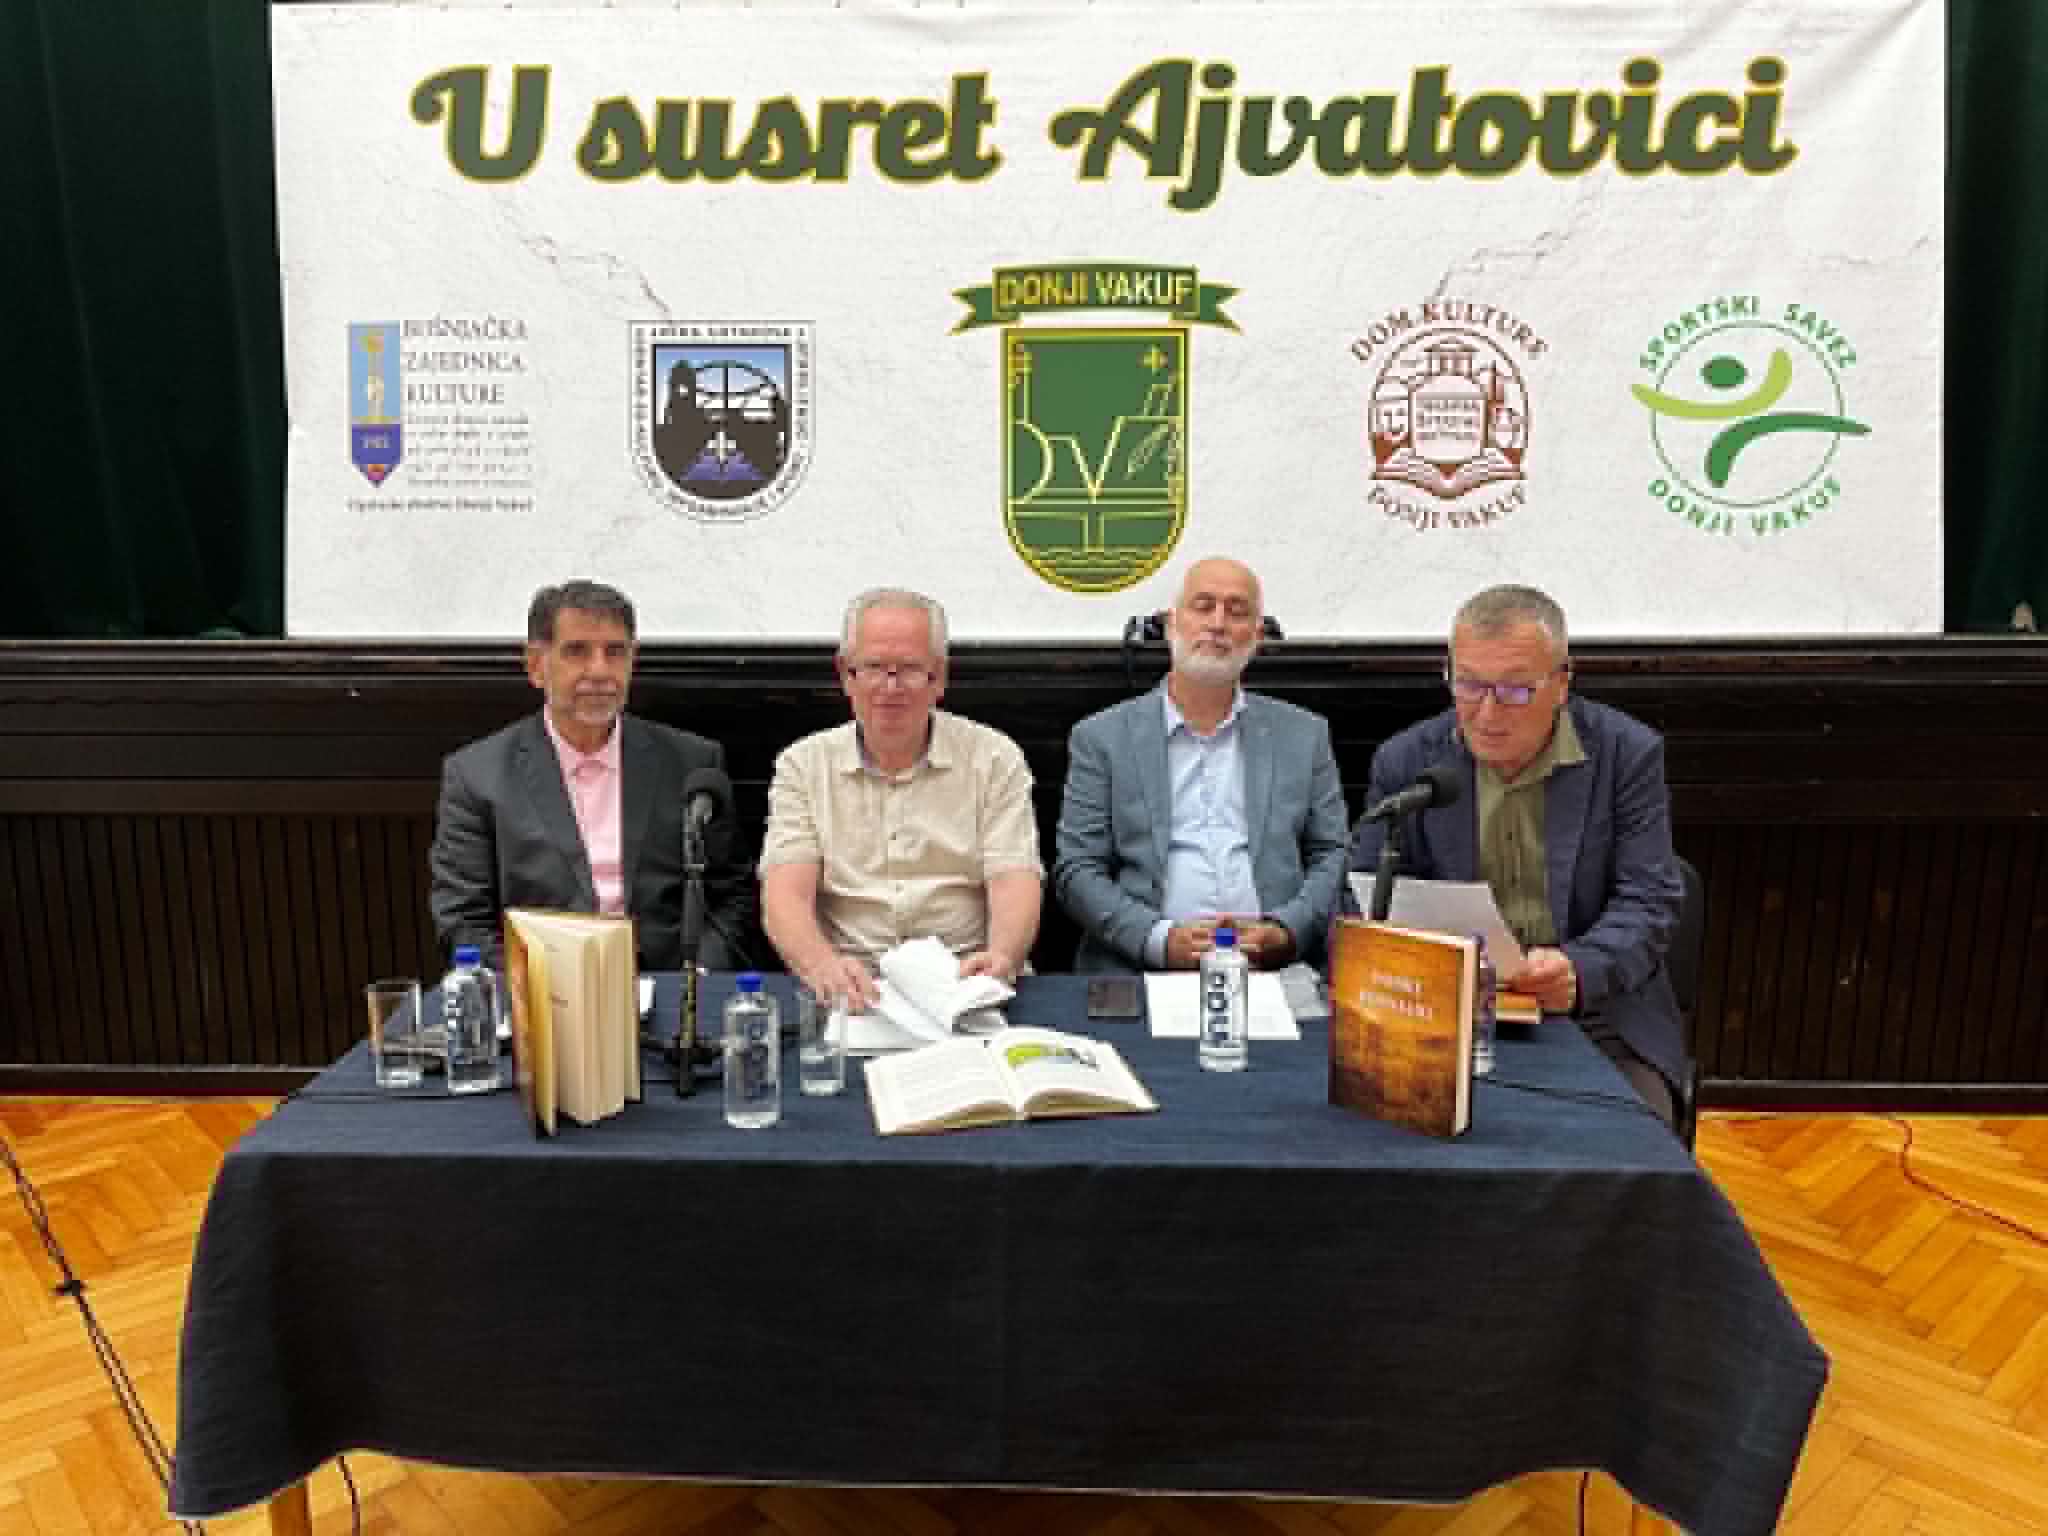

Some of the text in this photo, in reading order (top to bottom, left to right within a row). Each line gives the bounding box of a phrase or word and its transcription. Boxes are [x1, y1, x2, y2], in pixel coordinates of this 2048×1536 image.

[409, 57, 1800, 212] U susret Ajvatovici
[999, 269, 1191, 306] DONJI VAKUF
[1351, 300, 1550, 361] DOM KULTURE
[1638, 296, 1857, 372] SPORTSKI SAVEZ
[1648, 478, 1841, 538] DONJI VAKUF
